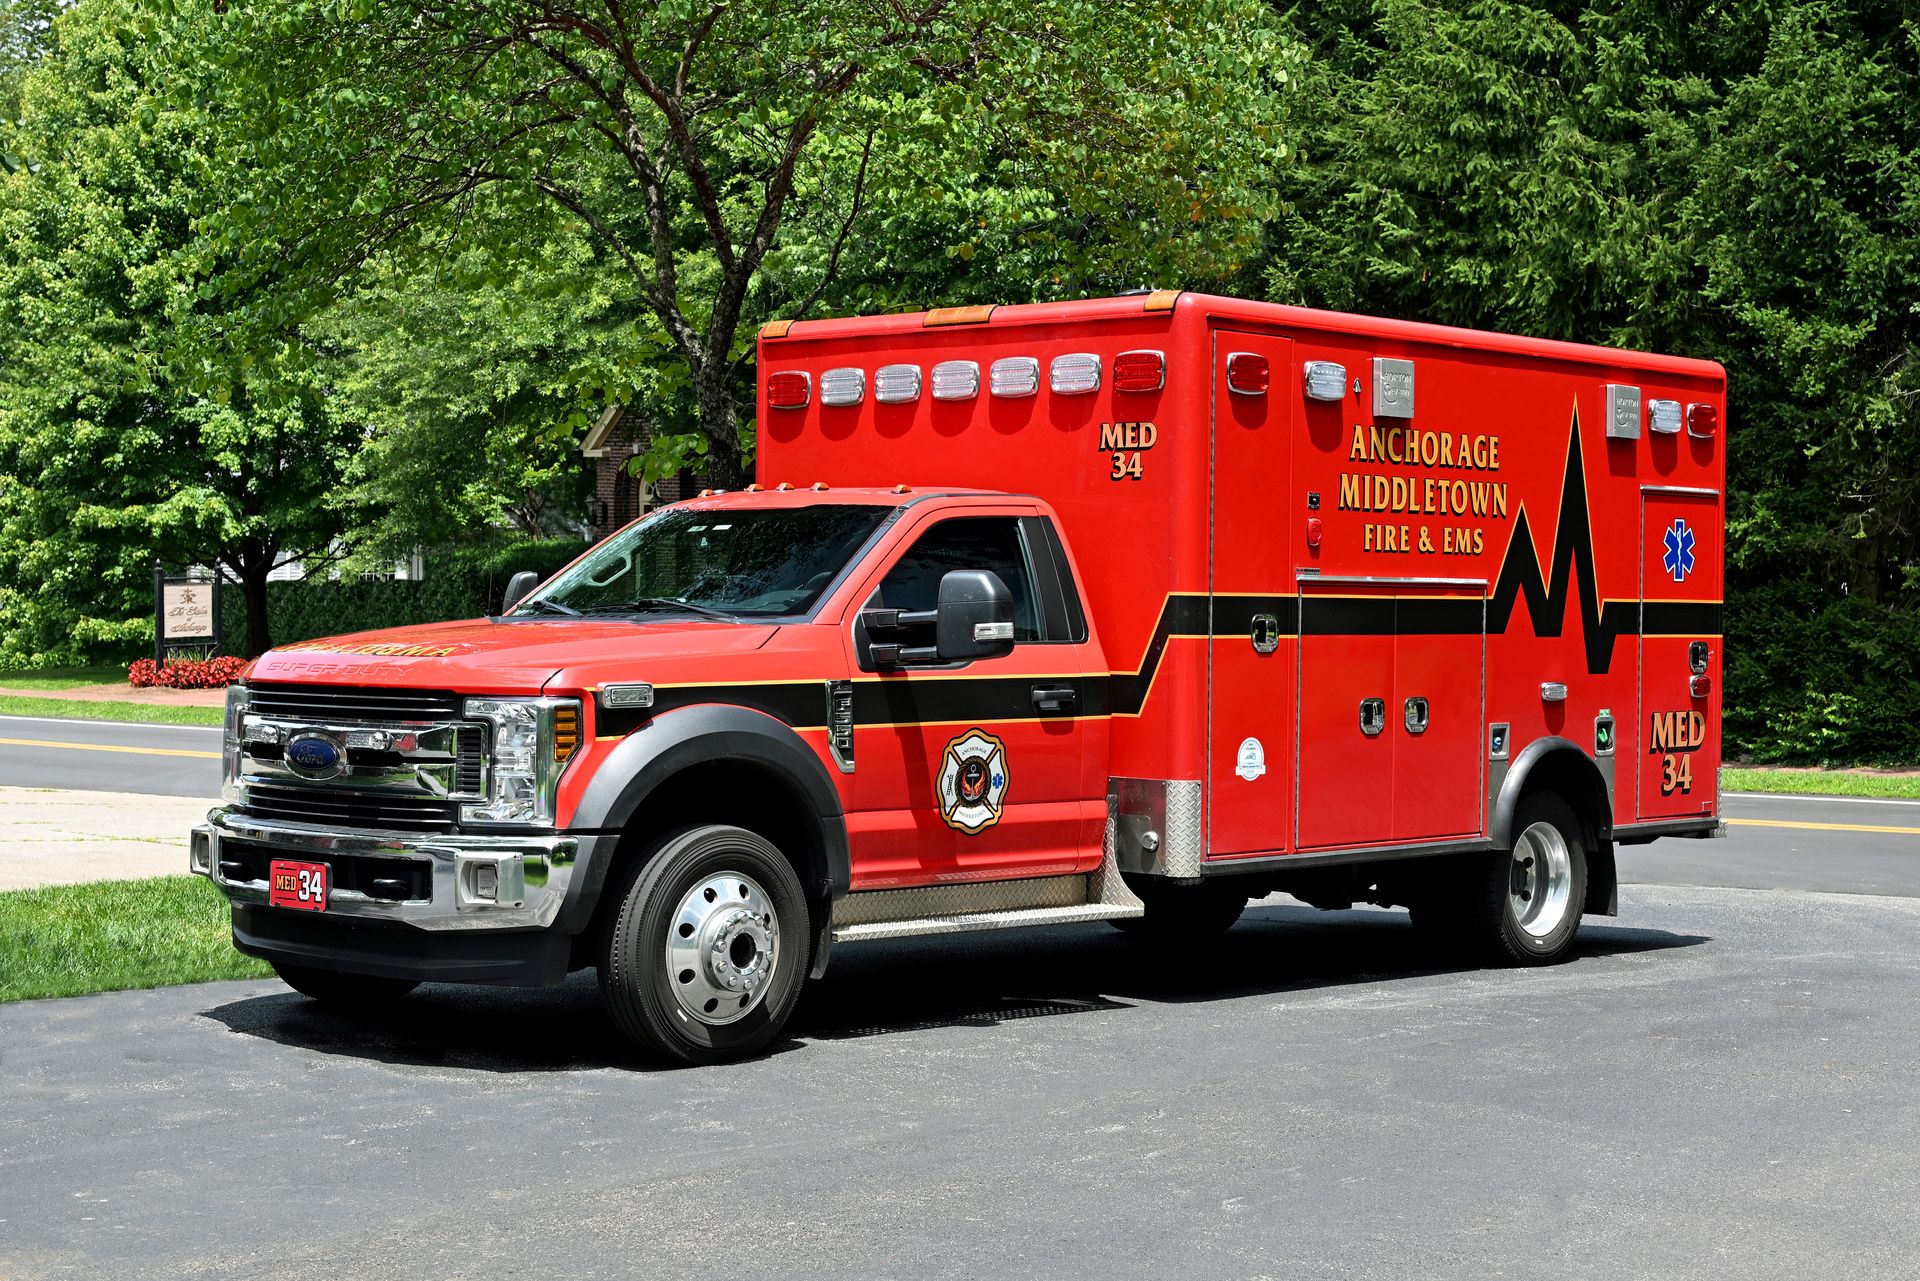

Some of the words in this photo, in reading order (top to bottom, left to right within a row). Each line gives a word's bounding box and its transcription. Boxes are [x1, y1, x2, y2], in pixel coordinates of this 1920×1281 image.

[1098, 422, 1158, 452] MED
[1349, 424, 1500, 471] ANCHORAGE
[1111, 451, 1144, 481] 34
[1338, 473, 1507, 519] MIDDLETOWN
[1364, 523, 1411, 553] FIRE
[1418, 525, 1435, 552] &
[1443, 527, 1484, 555] EMS
[266, 661, 339, 676] SUPER
[340, 662, 415, 677] DUTY
[1649, 711, 1706, 754] MED
[1661, 753, 1693, 797] 34
[275, 874, 297, 891] MED
[298, 869, 323, 903] 34
